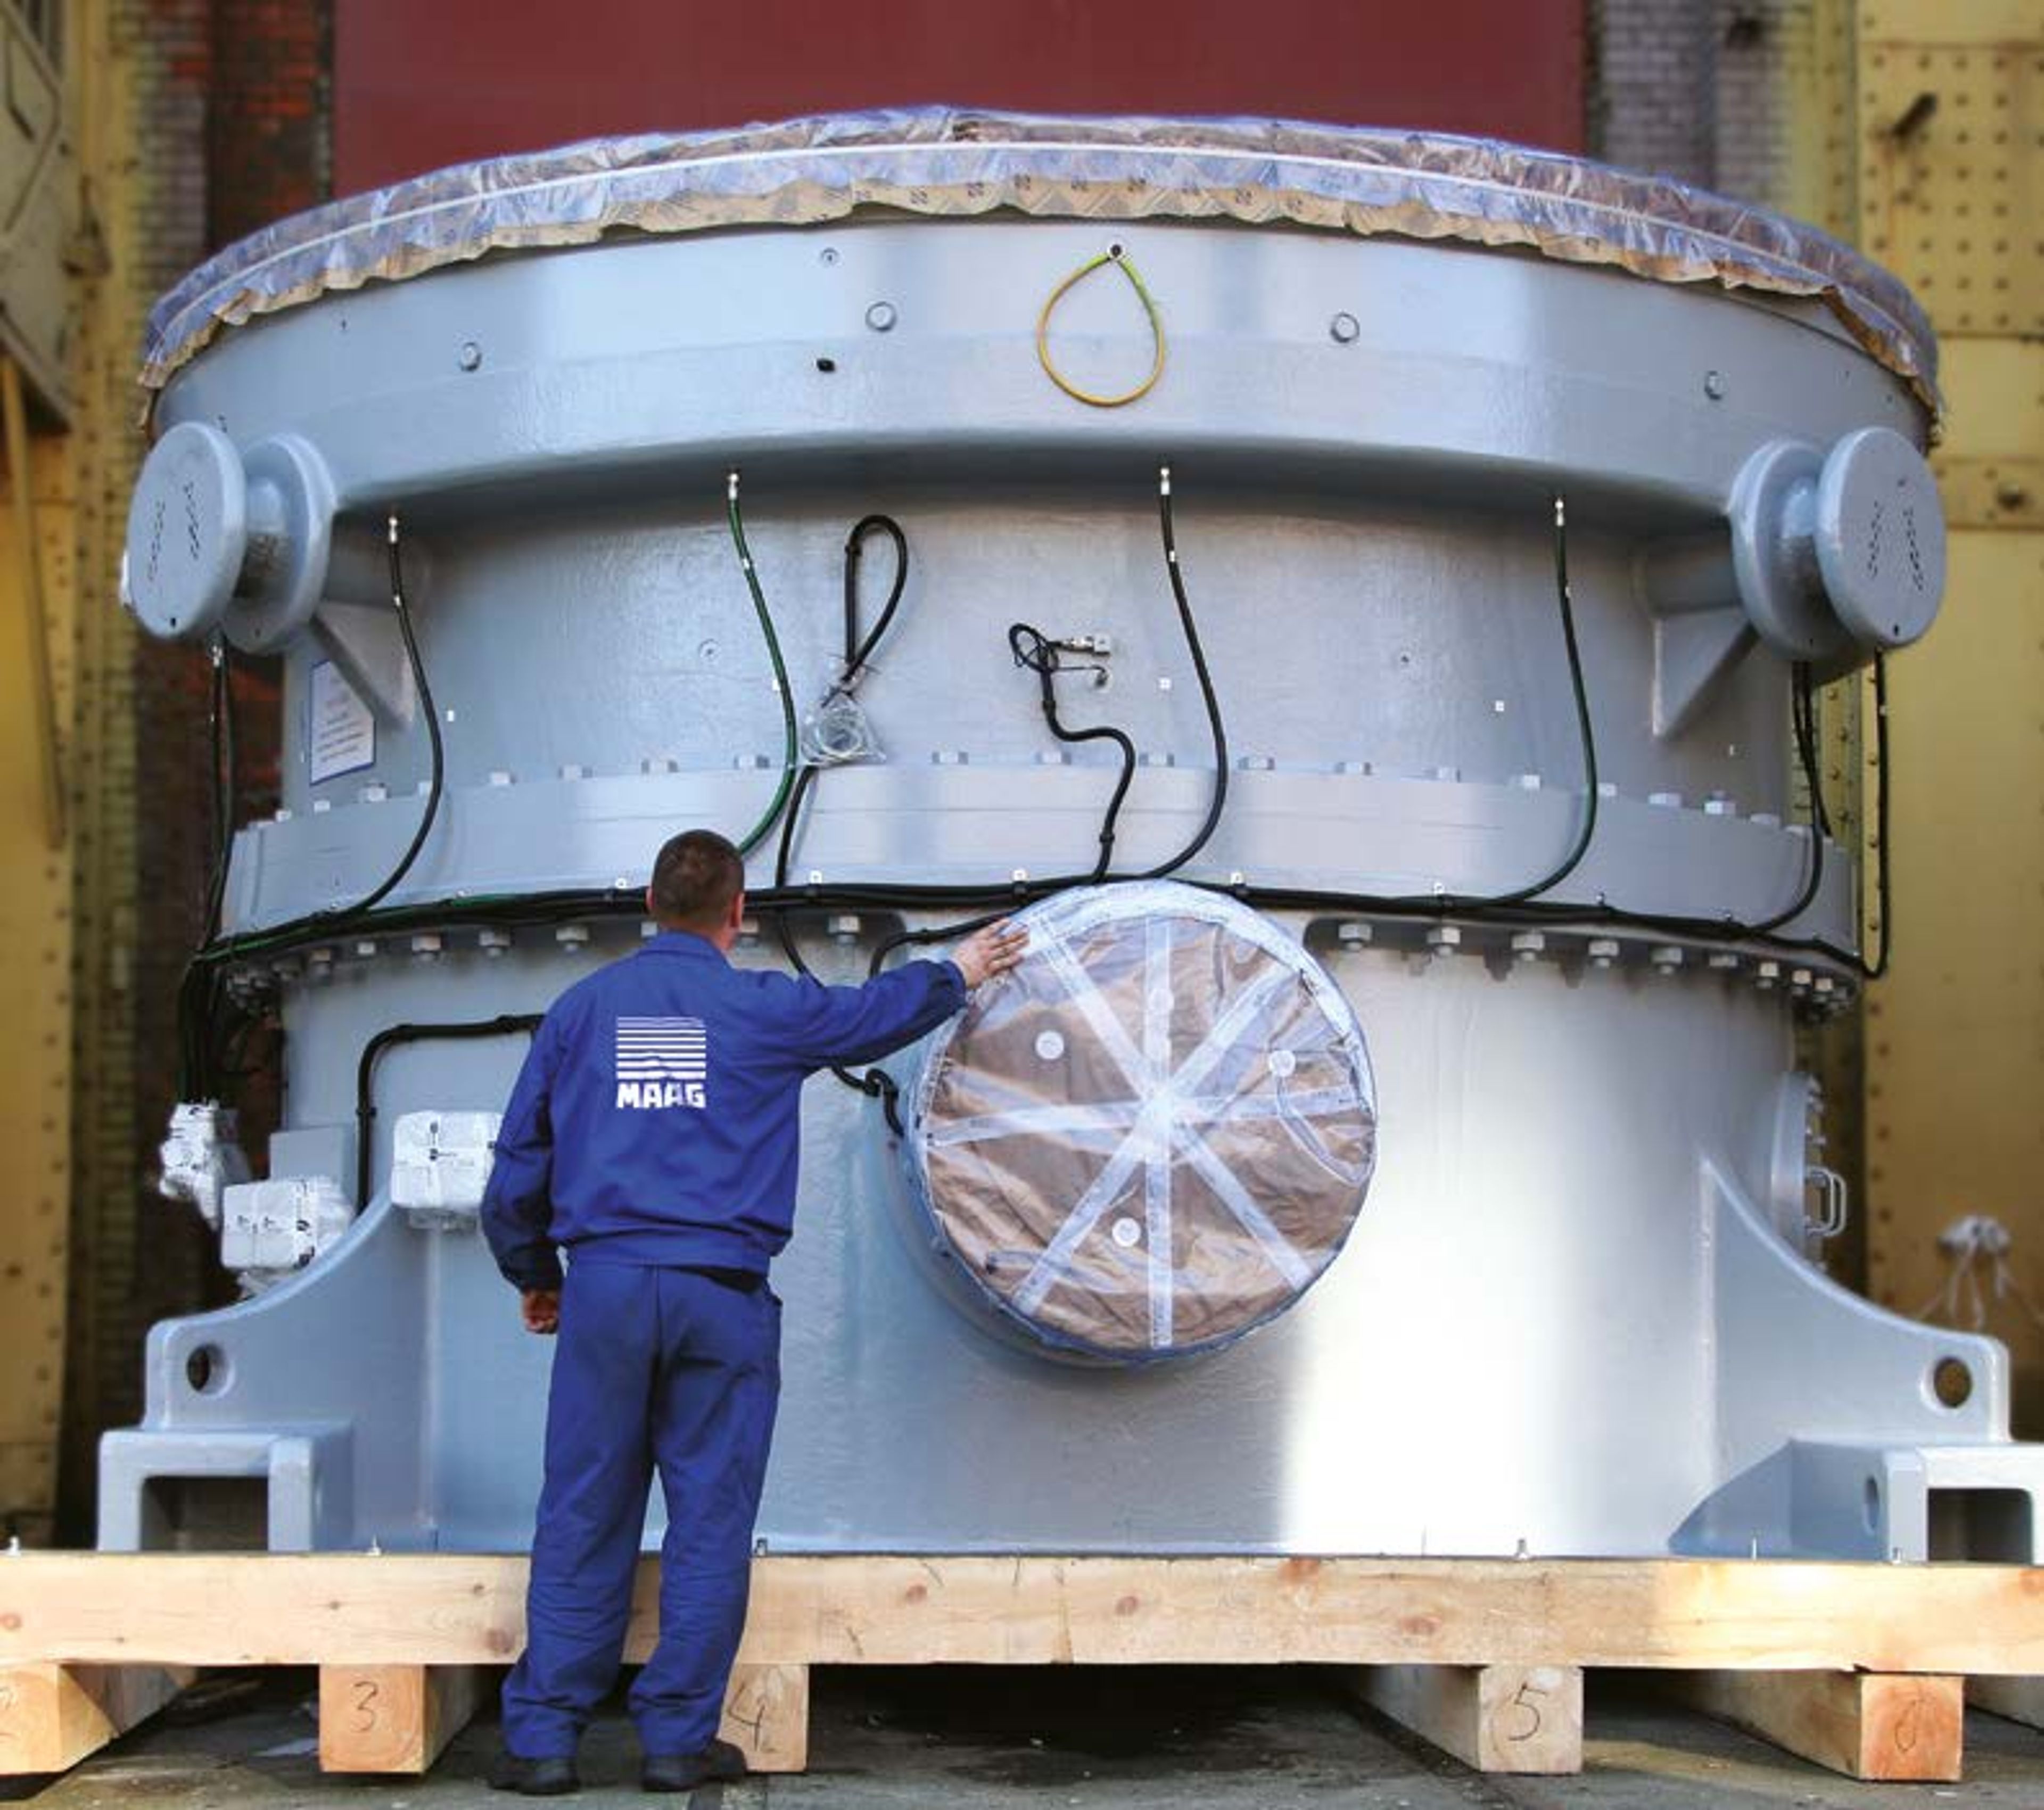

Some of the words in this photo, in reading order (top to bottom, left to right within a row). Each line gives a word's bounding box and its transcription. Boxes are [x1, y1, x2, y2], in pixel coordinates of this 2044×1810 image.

[616, 1081, 706, 1109] MAAG
[351, 1680, 379, 1733] 3
[727, 1681, 766, 1752] 4
[1508, 1682, 1550, 1741] 5
